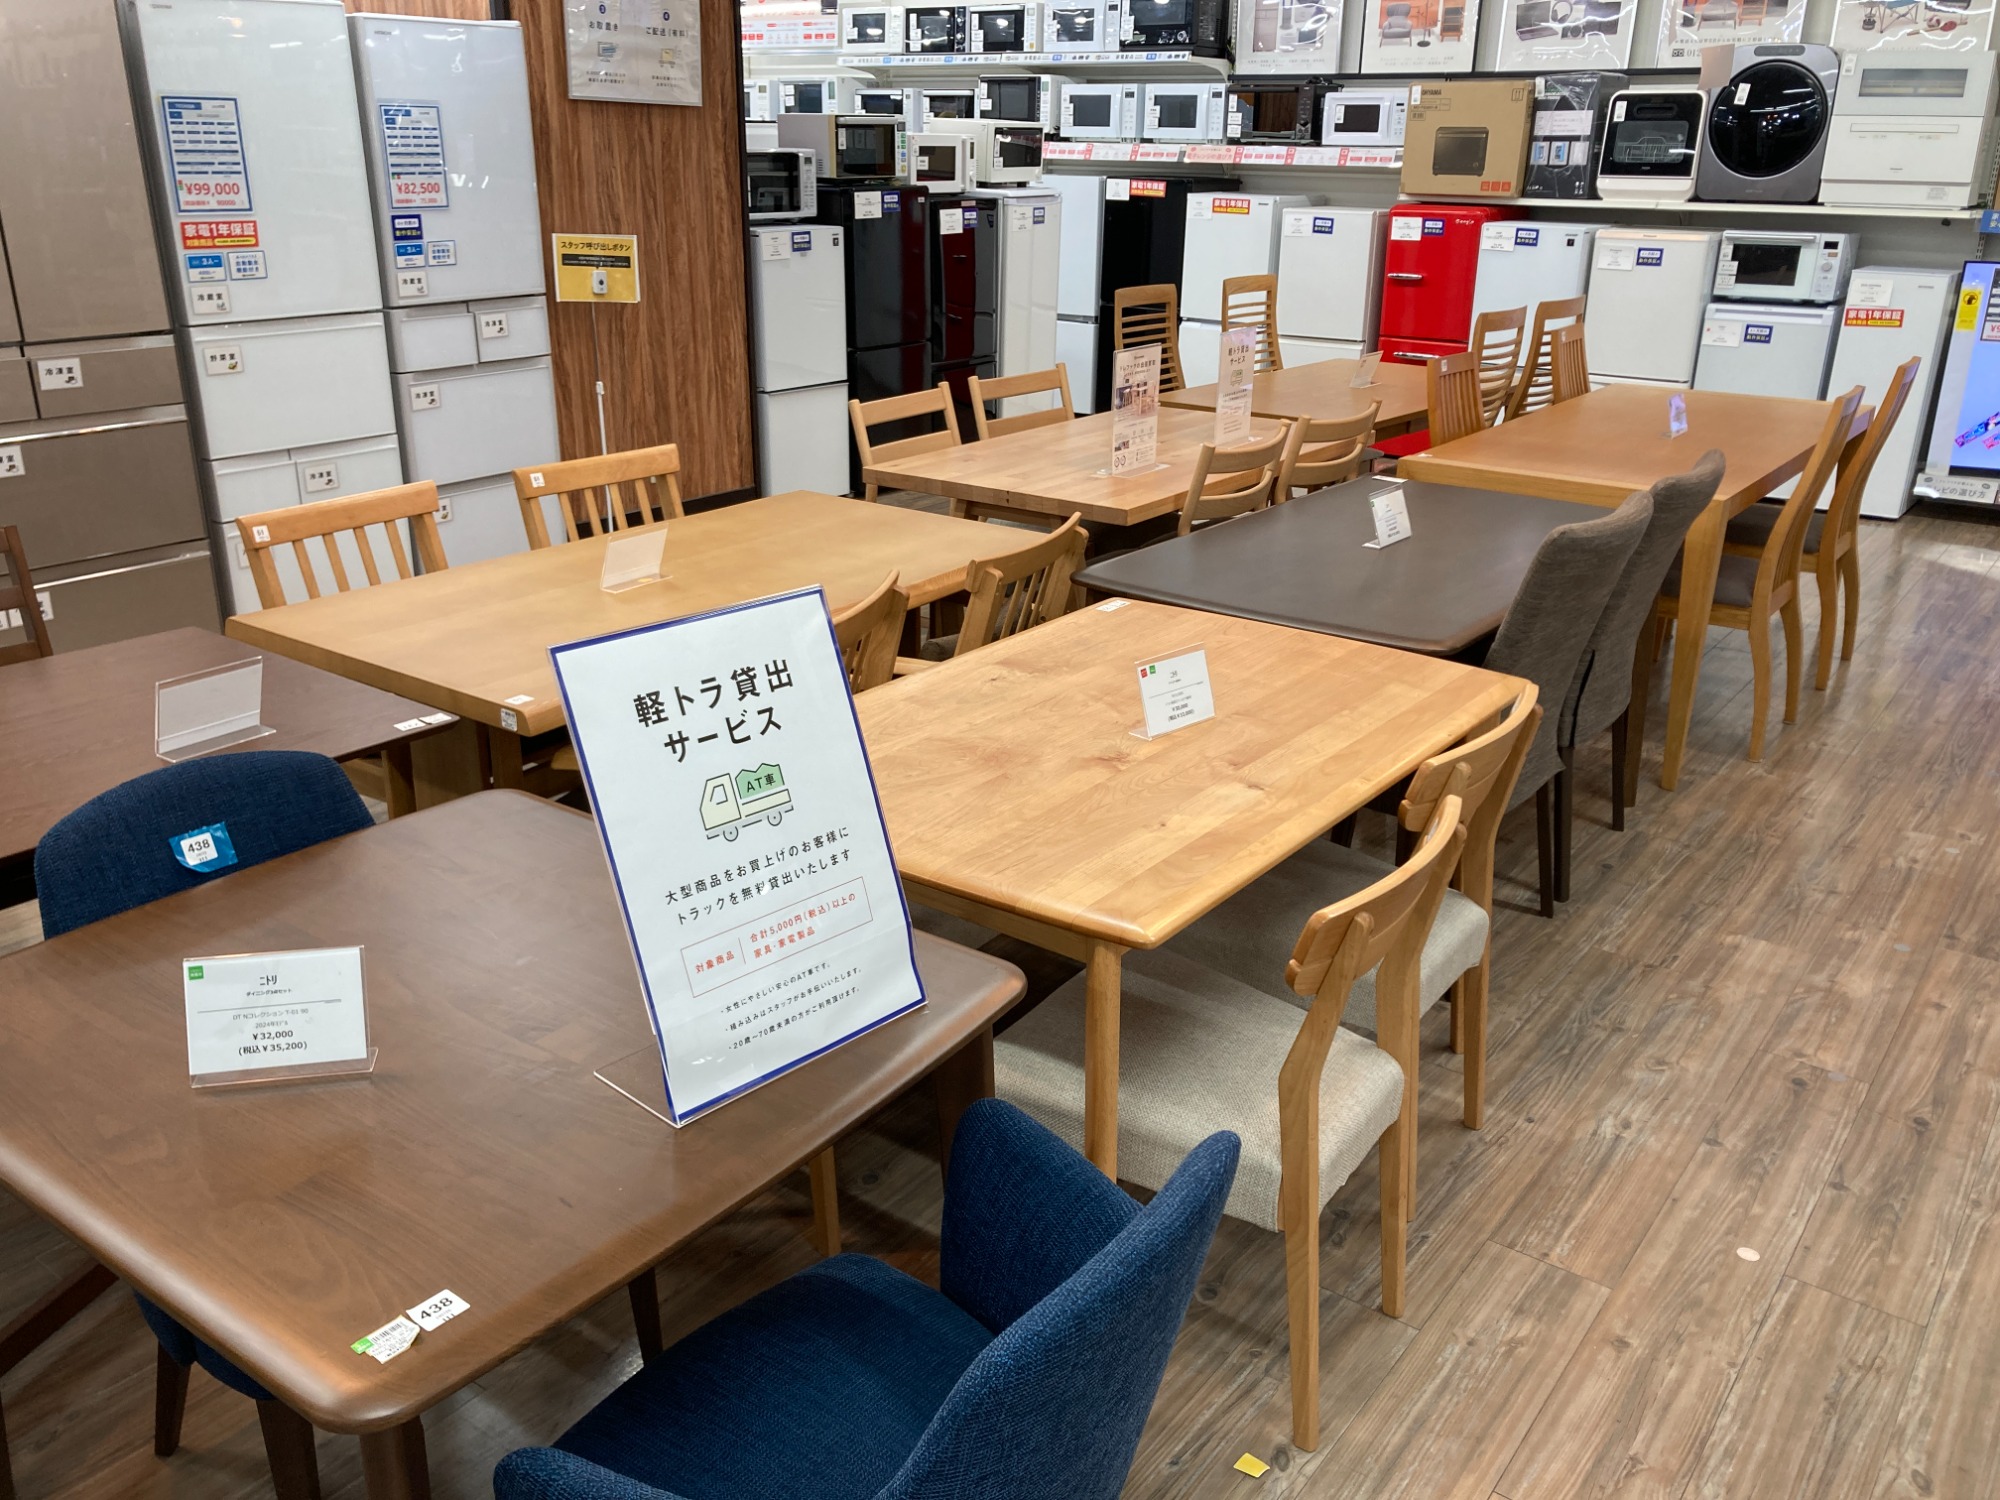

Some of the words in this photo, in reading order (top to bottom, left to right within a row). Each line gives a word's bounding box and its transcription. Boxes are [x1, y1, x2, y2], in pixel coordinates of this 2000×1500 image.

[184, 182, 241, 197] ¥99,000
[396, 182, 441, 196] ¥82,500
[184, 222, 256, 237] 家電1年保証
[560, 241, 631, 252] スタッフ呼び出しボタン
[1848, 310, 1903, 320] 家電1年保証
[210, 353, 236, 362] 野菜室
[45, 366, 74, 376] 冷凍室
[633, 659, 793, 728] 軽トラ貸出
[664, 706, 782, 763] サービス
[746, 773, 776, 793] AT車
[188, 839, 210, 853] 438
[665, 826, 849, 906] 大型商品をお買上げのお客様に
[677, 848, 850, 926] トラックを無料貸出いたします
[753, 926, 816, 959] 家具・家電製品
[695, 950, 735, 974] 対象商品
[259, 974, 278, 986] ニトリ
[252, 1030, 294, 1041] ¥32,000
[420, 1297, 453, 1320] 438
